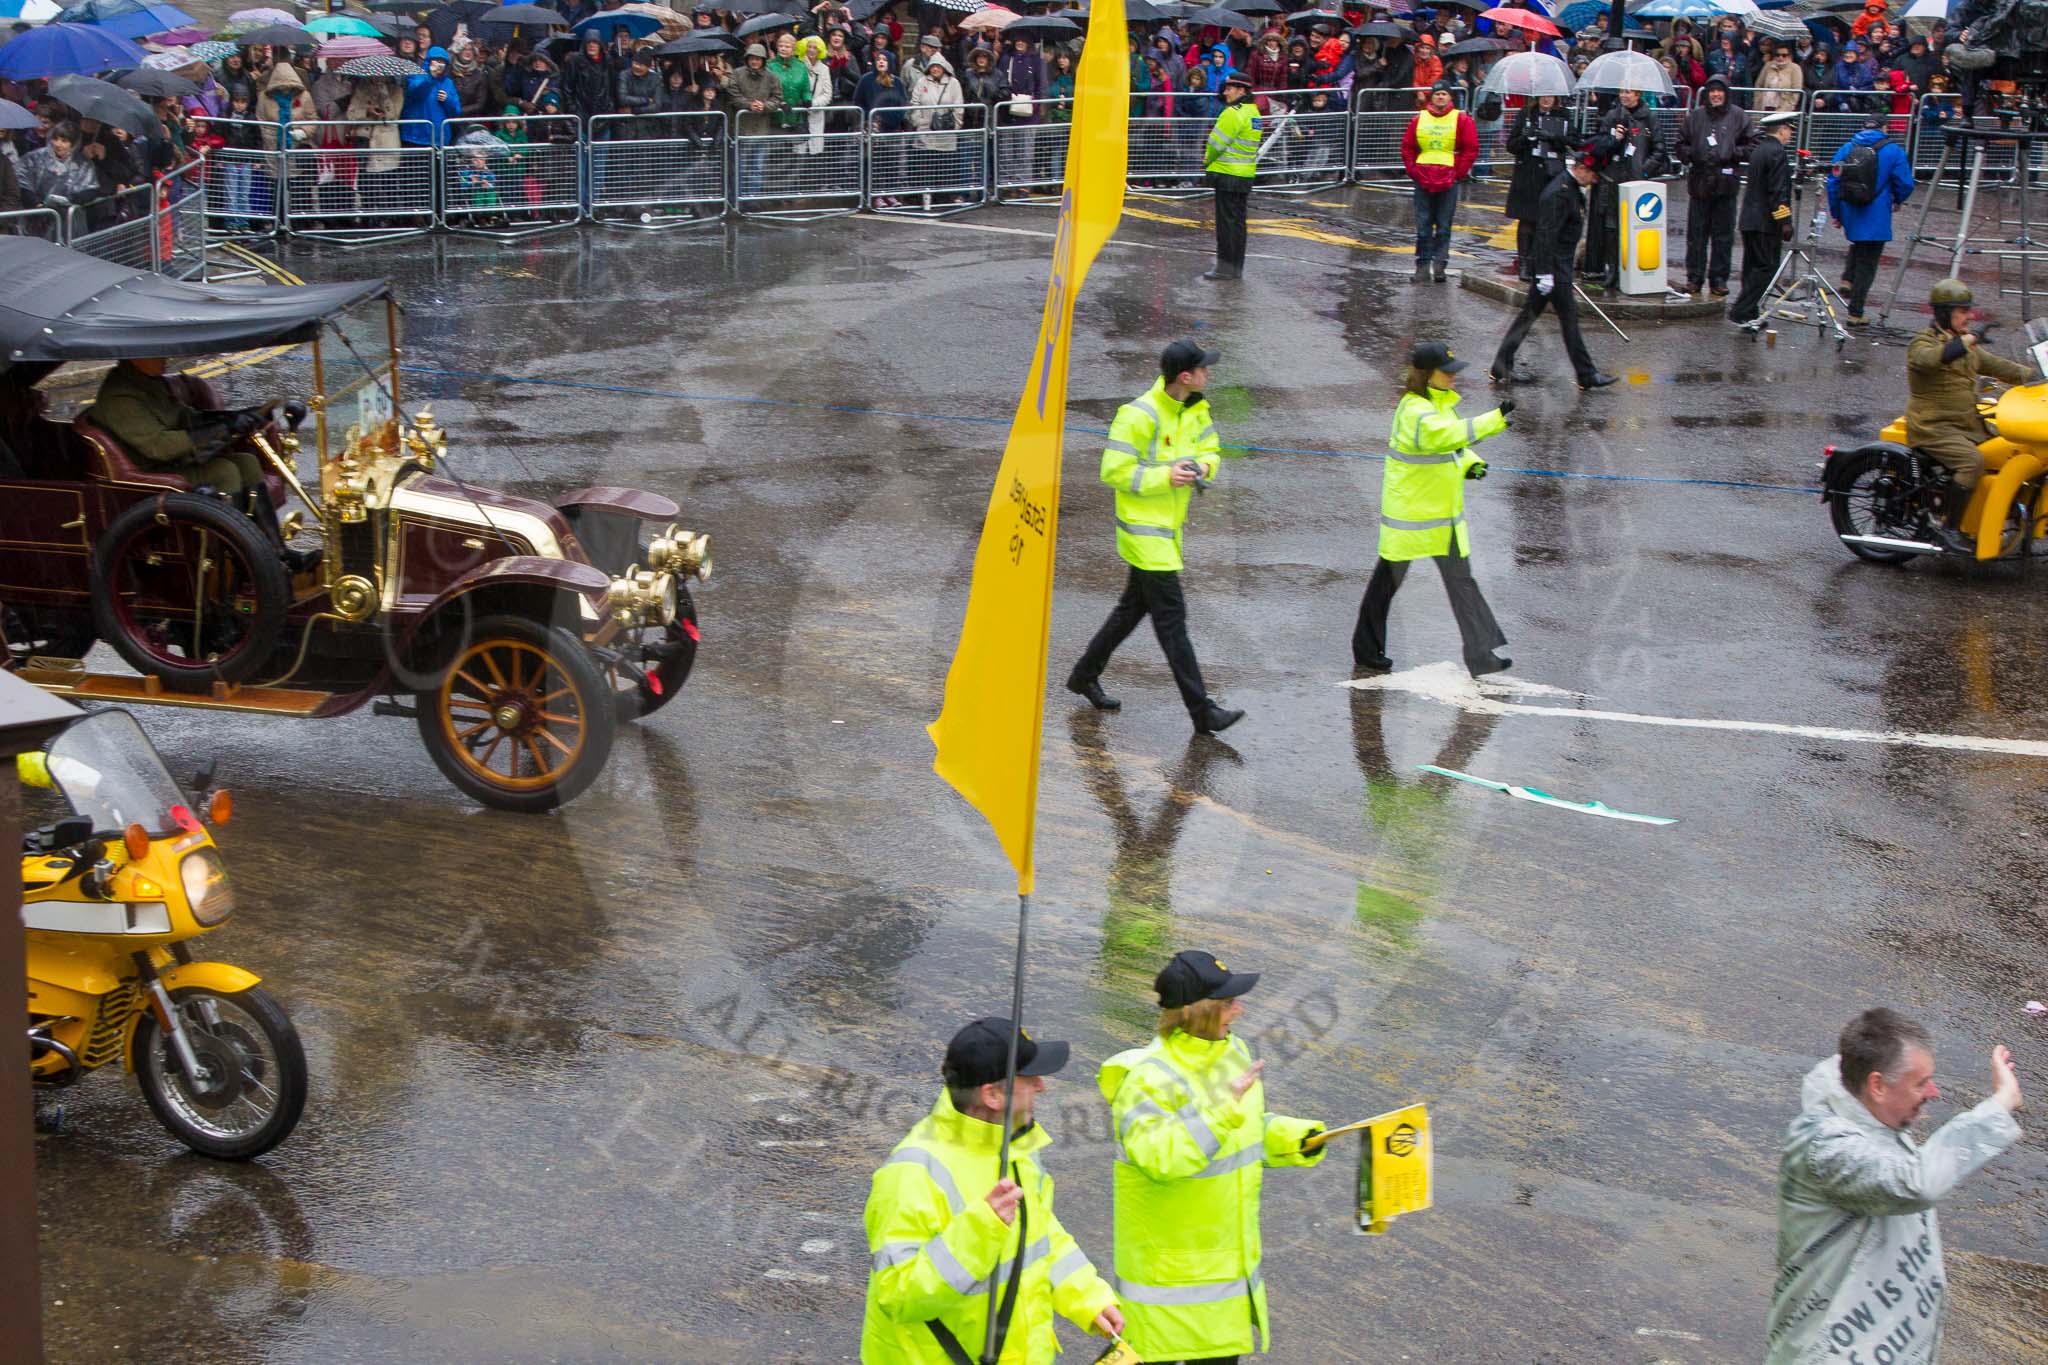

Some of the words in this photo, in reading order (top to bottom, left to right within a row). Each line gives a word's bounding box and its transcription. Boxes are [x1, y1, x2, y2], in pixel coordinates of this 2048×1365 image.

[1866, 1279, 1902, 1309] is
[1897, 1234, 1931, 1283] the
[1874, 1316, 1916, 1365] our
